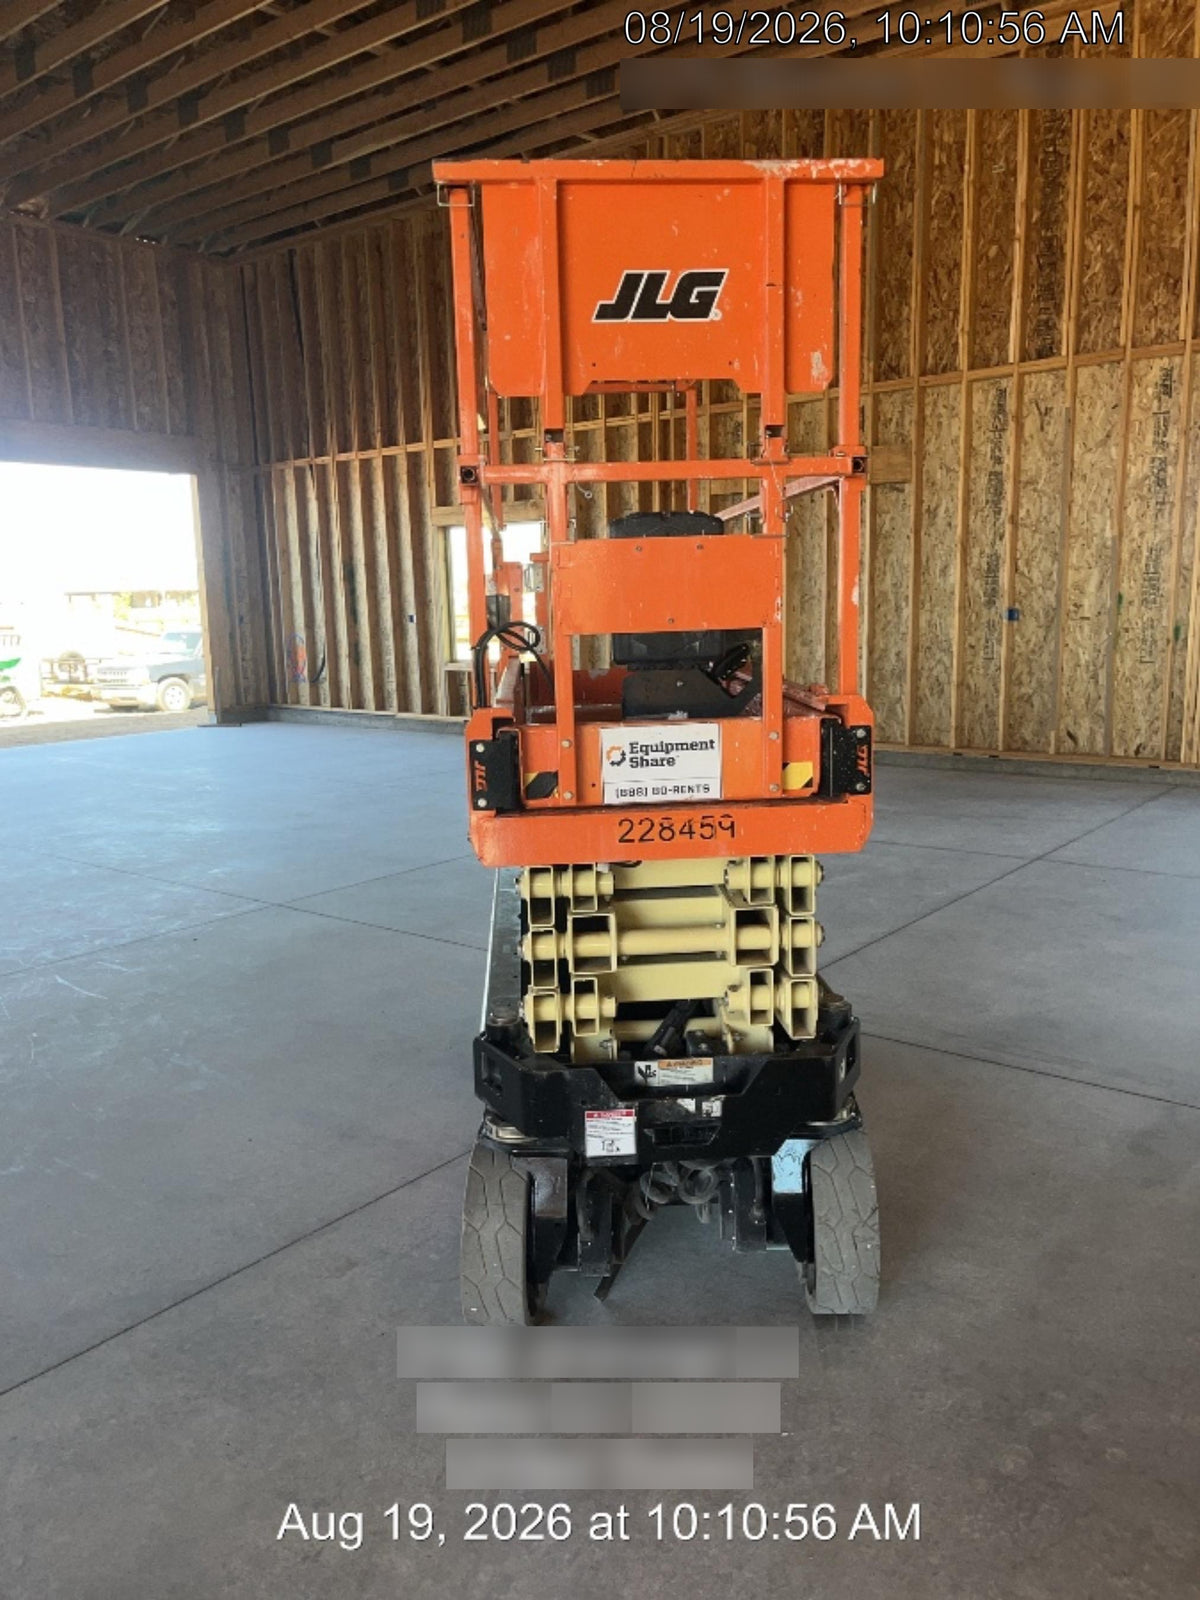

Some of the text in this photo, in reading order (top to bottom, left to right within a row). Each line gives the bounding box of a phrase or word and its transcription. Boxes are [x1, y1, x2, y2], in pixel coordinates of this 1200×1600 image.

[592, 269, 729, 322] JLG
[629, 739, 715, 756] Equipment
[629, 755, 677, 768] Share
[474, 760, 488, 792] JLG
[617, 813, 736, 844] 228459
